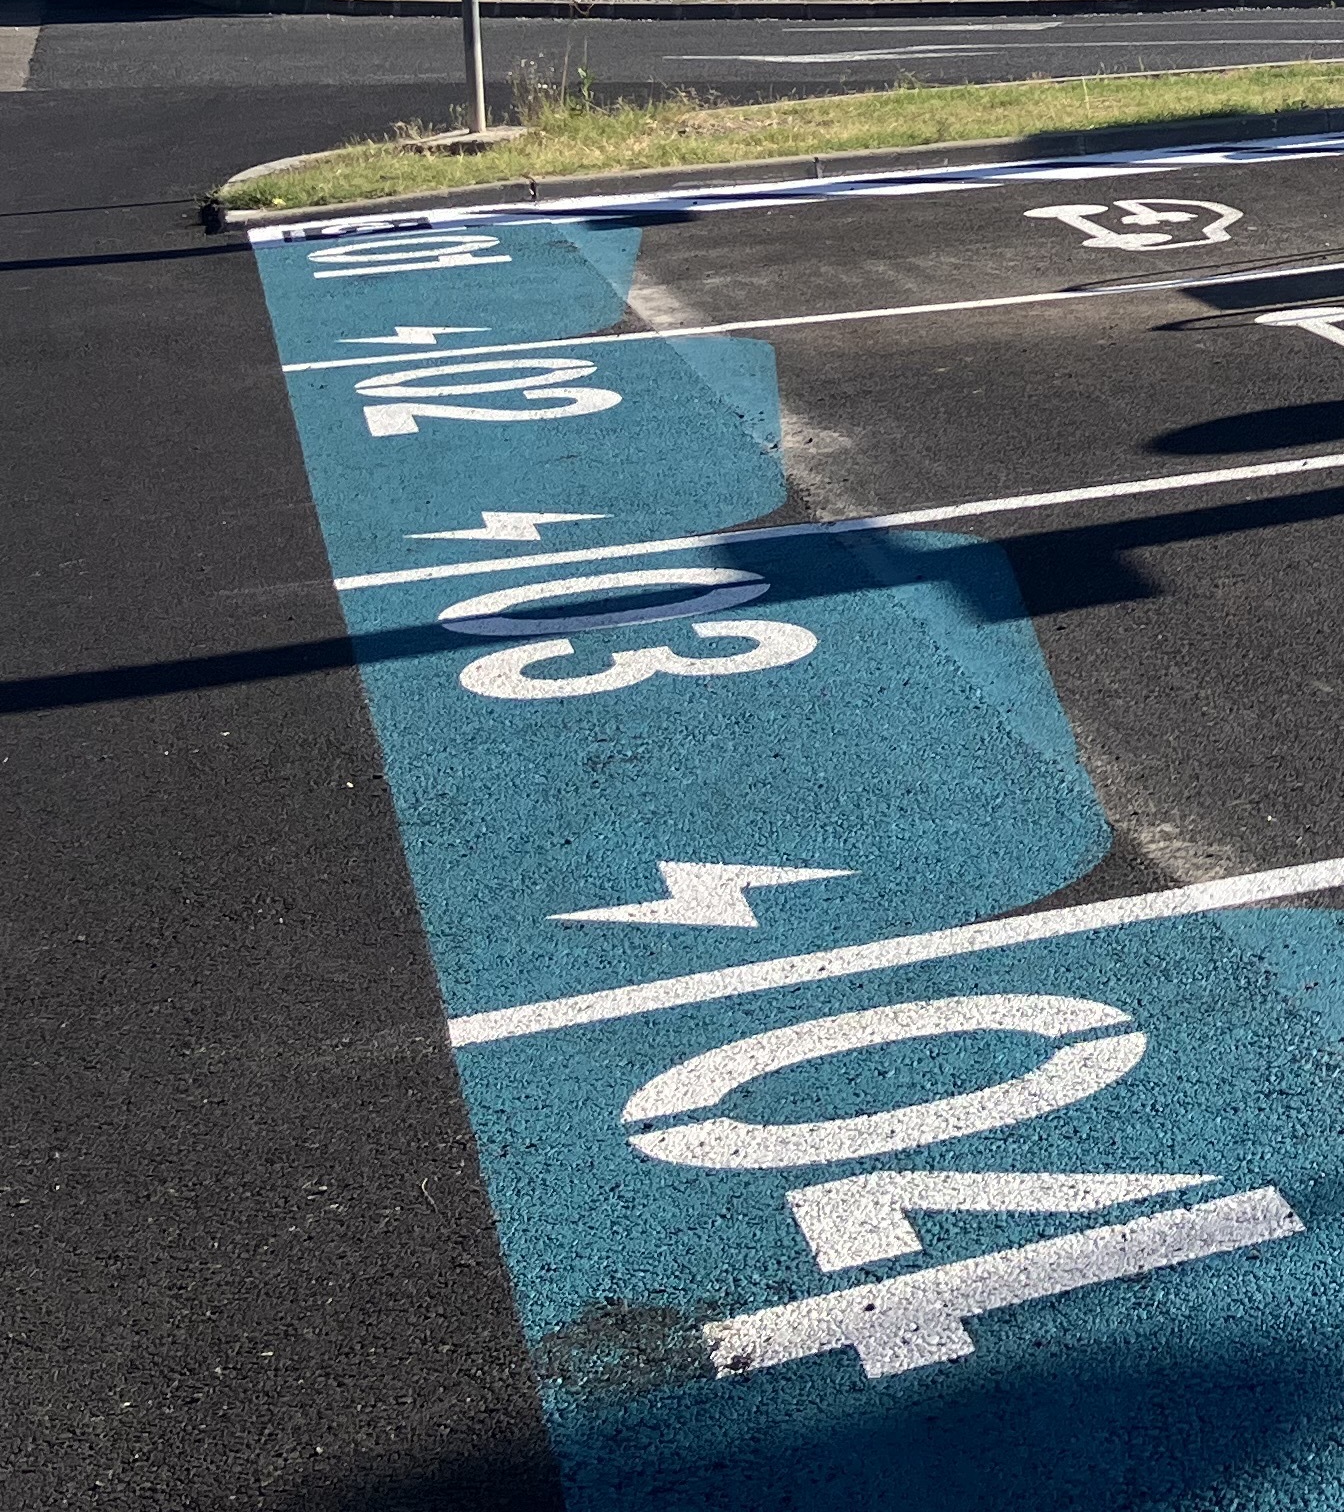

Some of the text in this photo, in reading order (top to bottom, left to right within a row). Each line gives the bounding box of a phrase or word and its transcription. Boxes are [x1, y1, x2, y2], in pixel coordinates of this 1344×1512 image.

[308, 234, 513, 279] 01
[354, 357, 623, 438] 02
[438, 567, 819, 700] 03
[620, 992, 1306, 1380] 04
